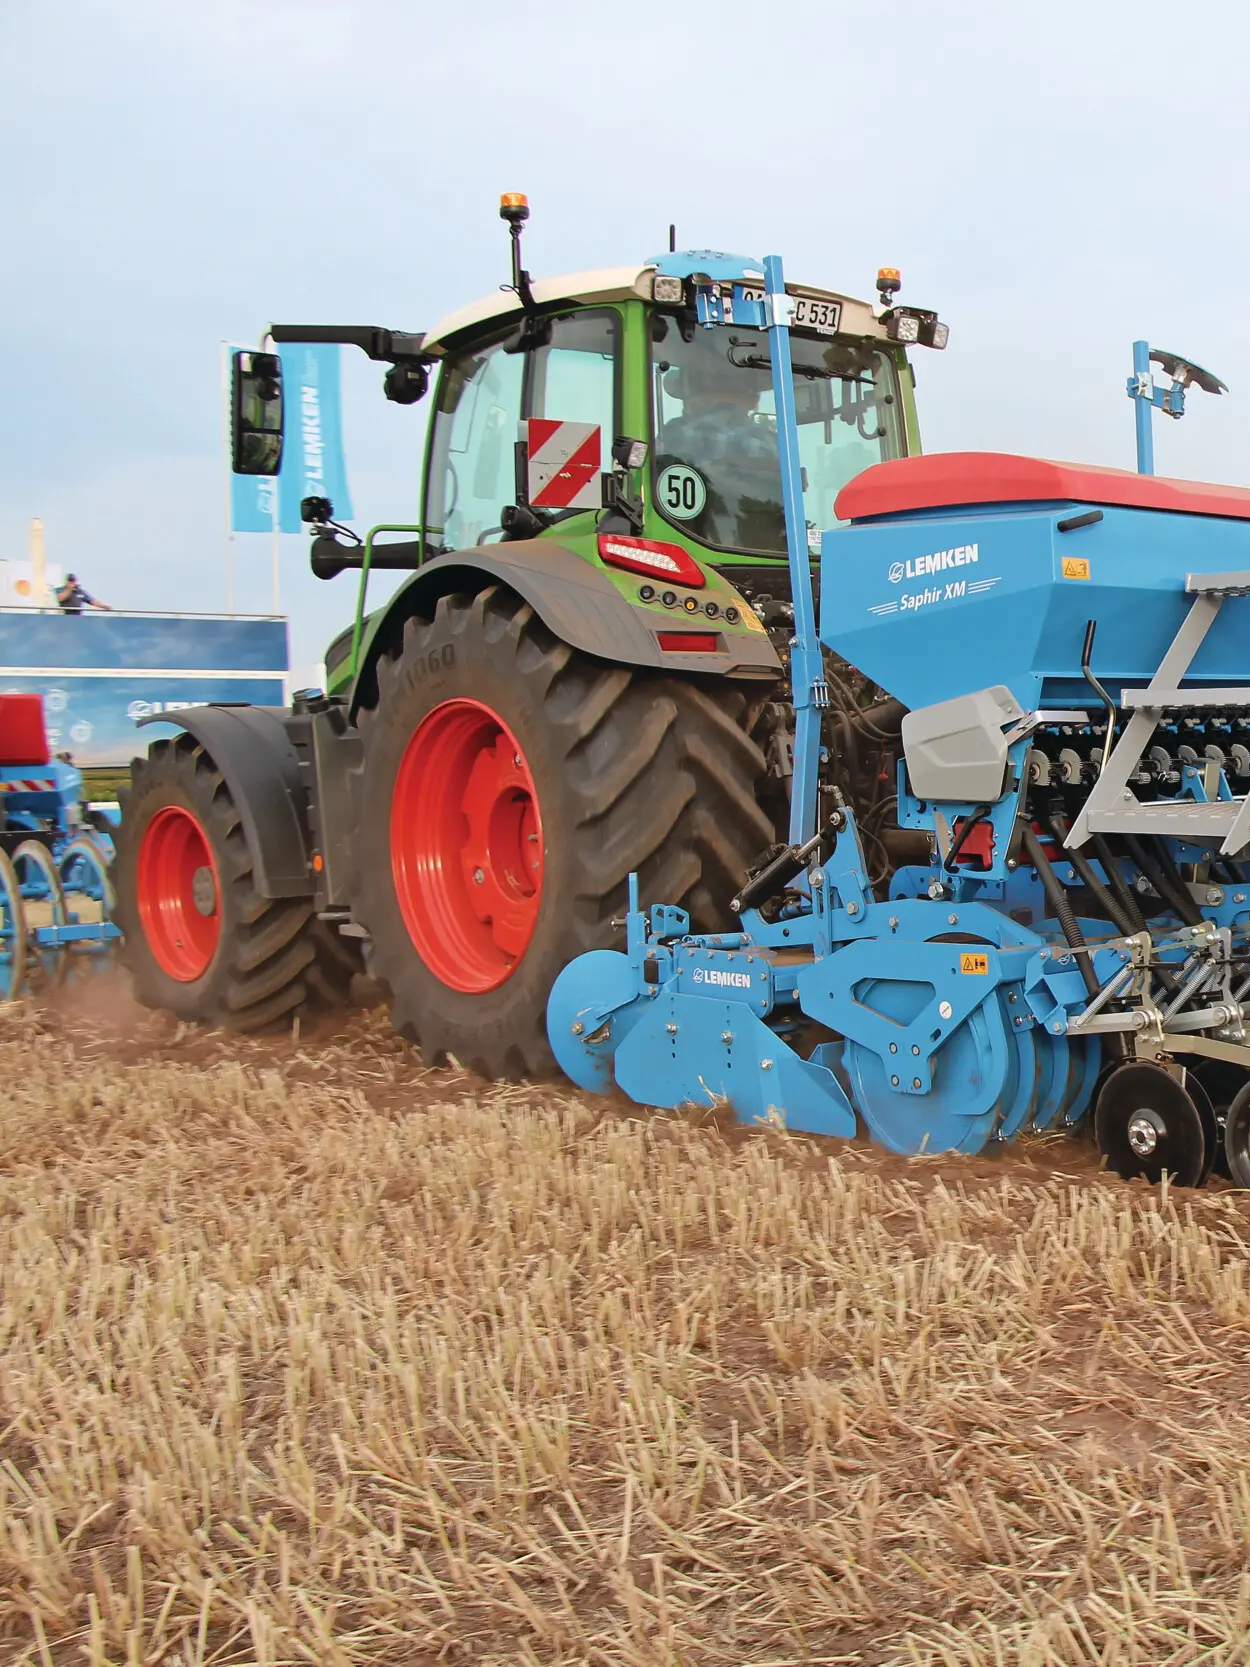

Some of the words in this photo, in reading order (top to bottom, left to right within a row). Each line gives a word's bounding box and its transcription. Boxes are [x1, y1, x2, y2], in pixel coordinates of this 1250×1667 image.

[809, 303, 837, 327] 531
[301, 385, 325, 480] LEMKEN
[667, 474, 696, 511] 50
[905, 543, 979, 579] LEMKEN
[899, 586, 942, 612] Saphir
[943, 580, 966, 601] XM
[704, 969, 751, 988] LEMKEN
